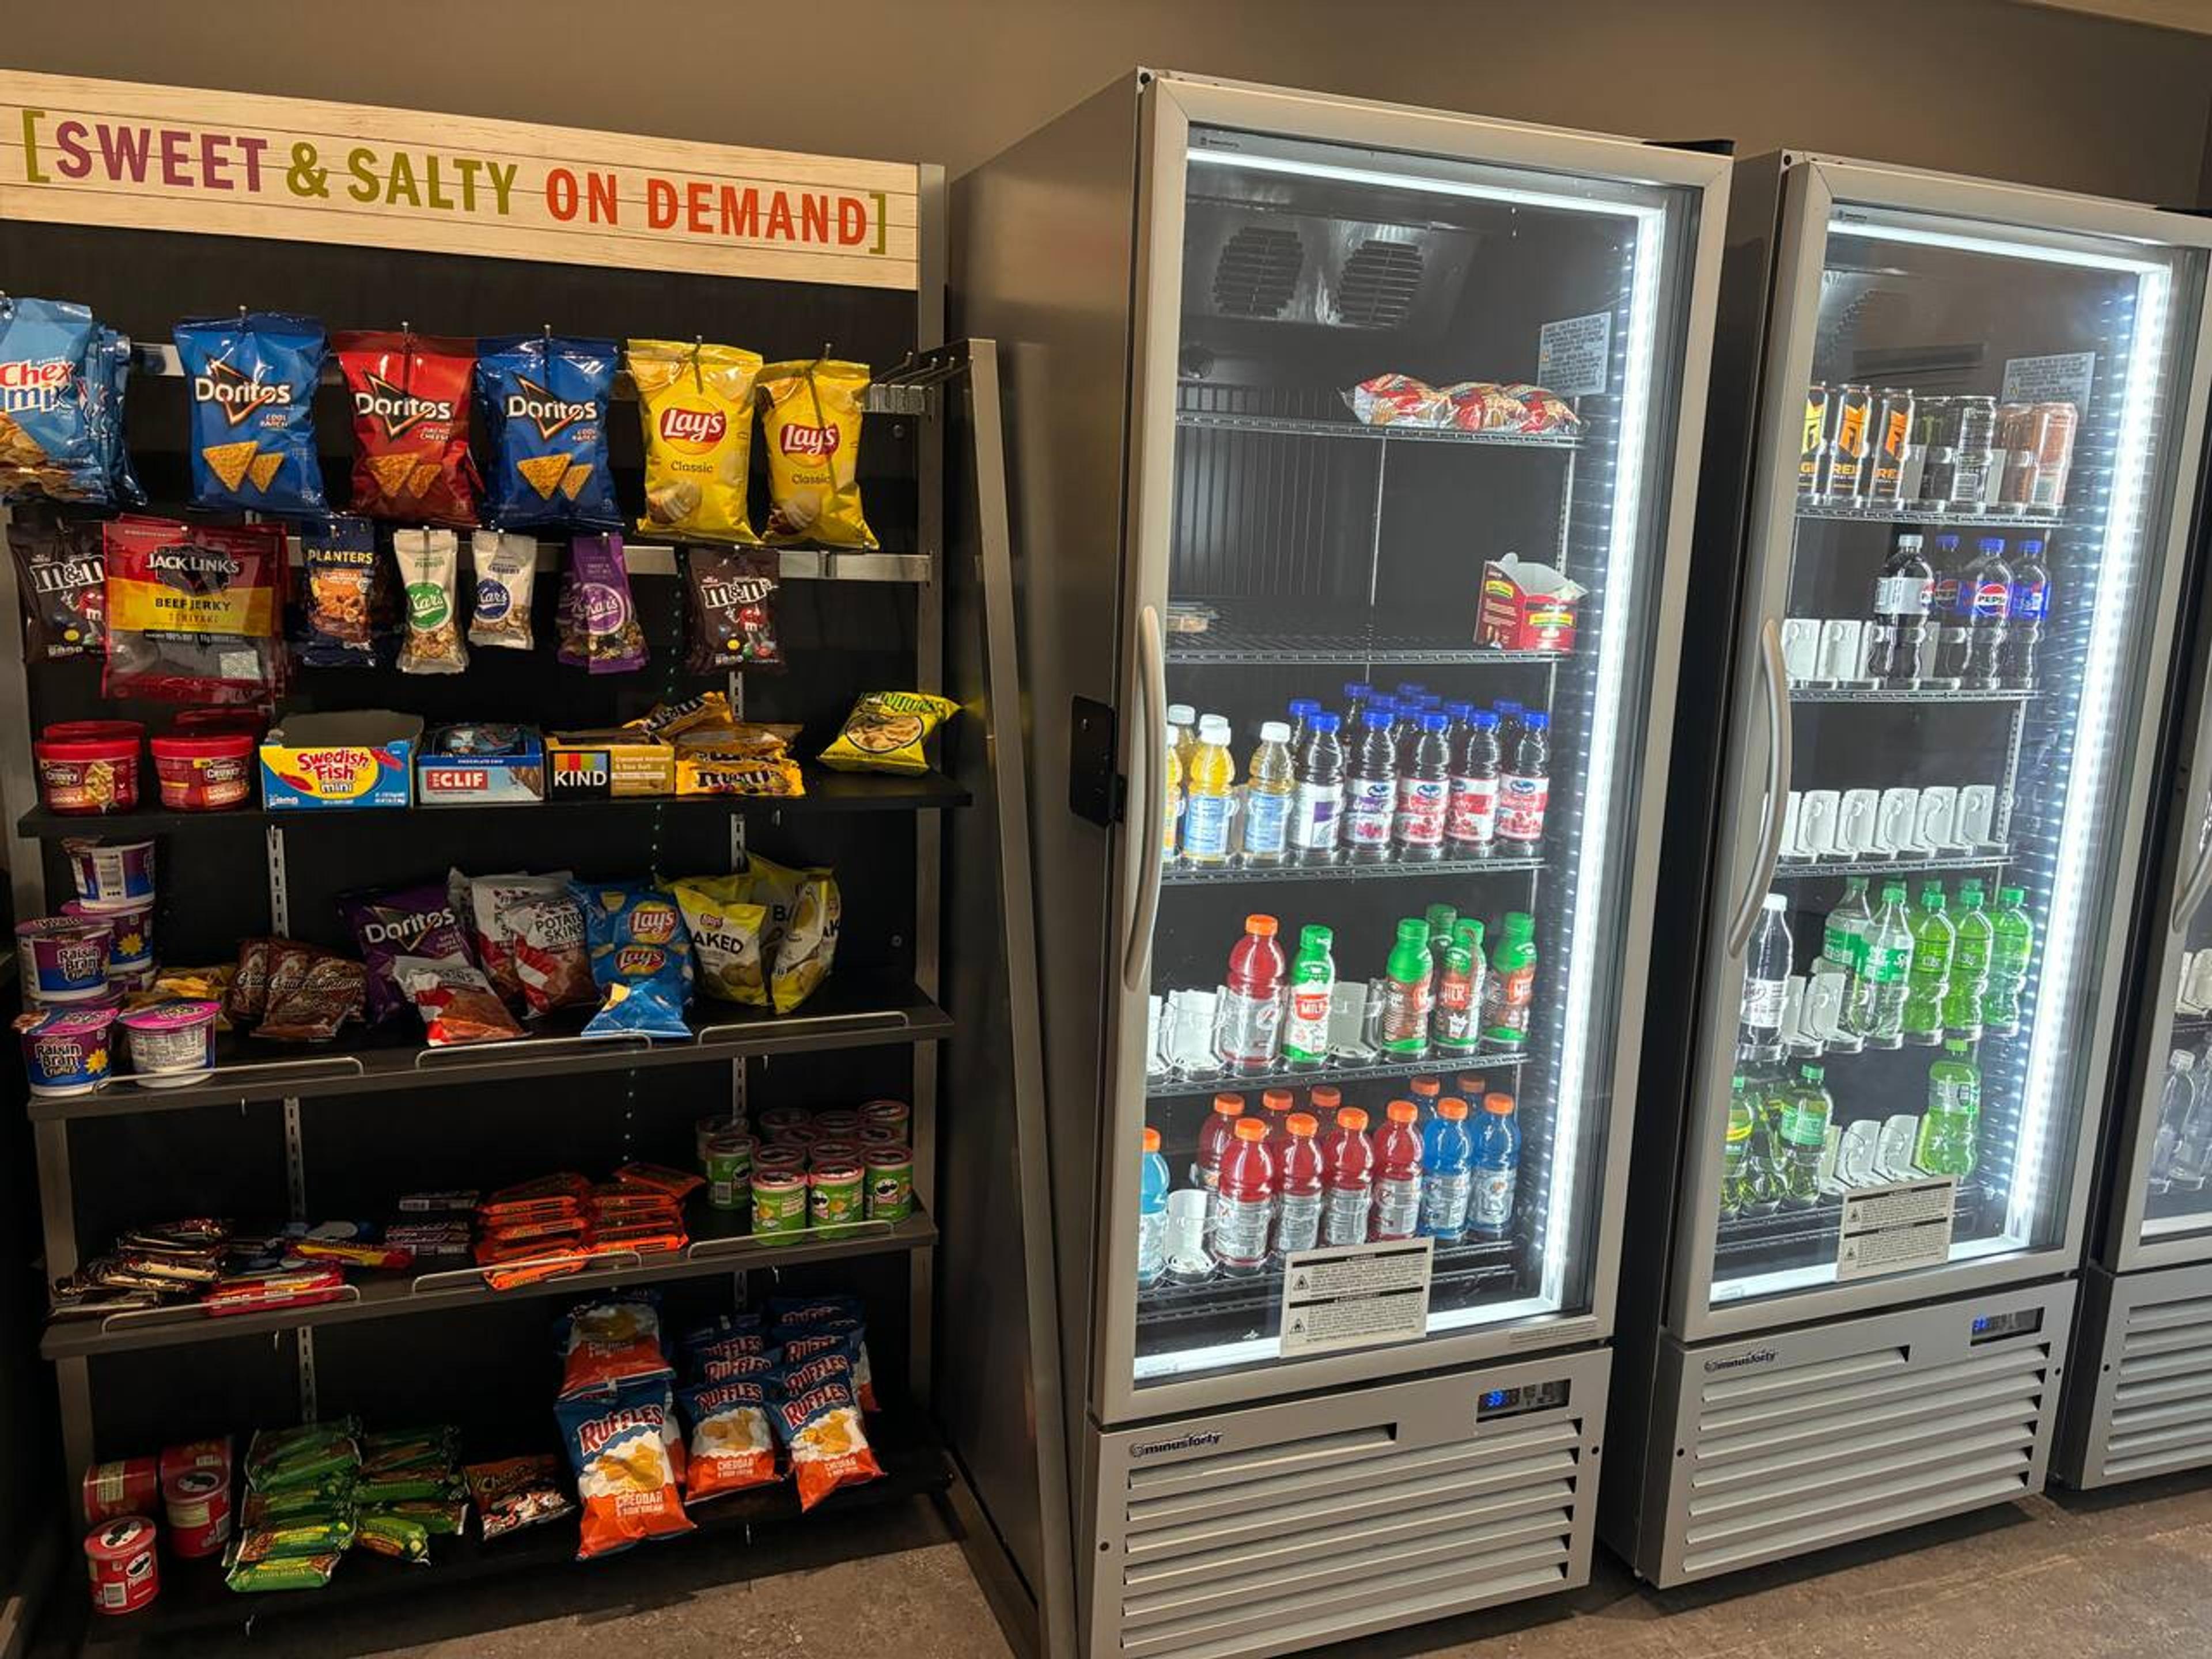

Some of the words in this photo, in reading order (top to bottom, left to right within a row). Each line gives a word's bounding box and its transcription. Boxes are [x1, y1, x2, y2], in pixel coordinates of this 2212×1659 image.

[286, 142, 329, 198] &
[347, 148, 518, 215] SALTY
[546, 168, 618, 225] ON
[0, 362, 74, 387] Chex
[195, 378, 291, 404] Doritos
[355, 392, 452, 420] Doritos
[508, 396, 597, 420] Doritos
[664, 408, 724, 442] Lay's
[784, 425, 836, 455] Lay's
[671, 461, 714, 474] Classic
[791, 474, 830, 485] Classic
[145, 553, 188, 571] JACK
[308, 549, 374, 565] PLANTERS
[155, 597, 188, 609] BEEF
[188, 599, 231, 611] JERKY
[297, 749, 370, 771] Swedish
[314, 764, 355, 781] Fish
[440, 772, 483, 787] CLIF
[554, 770, 608, 786] KIND
[321, 783, 353, 793] mini
[365, 907, 456, 944] Doritos
[544, 922, 585, 942] SKINS
[634, 910, 675, 934] Lay's
[693, 930, 744, 955] AKED
[59, 946, 101, 962] Raisin
[66, 957, 99, 971] Bran
[35, 1044, 83, 1058] Raisin
[41, 1054, 78, 1068] Bran
[695, 1382, 763, 1412] RUFFLES
[781, 1382, 850, 1430] RUFFLES
[578, 1404, 664, 1456] RUFFLES
[1144, 1432, 1222, 1455] minusforty
[615, 1491, 664, 1509] CHEDDAR
